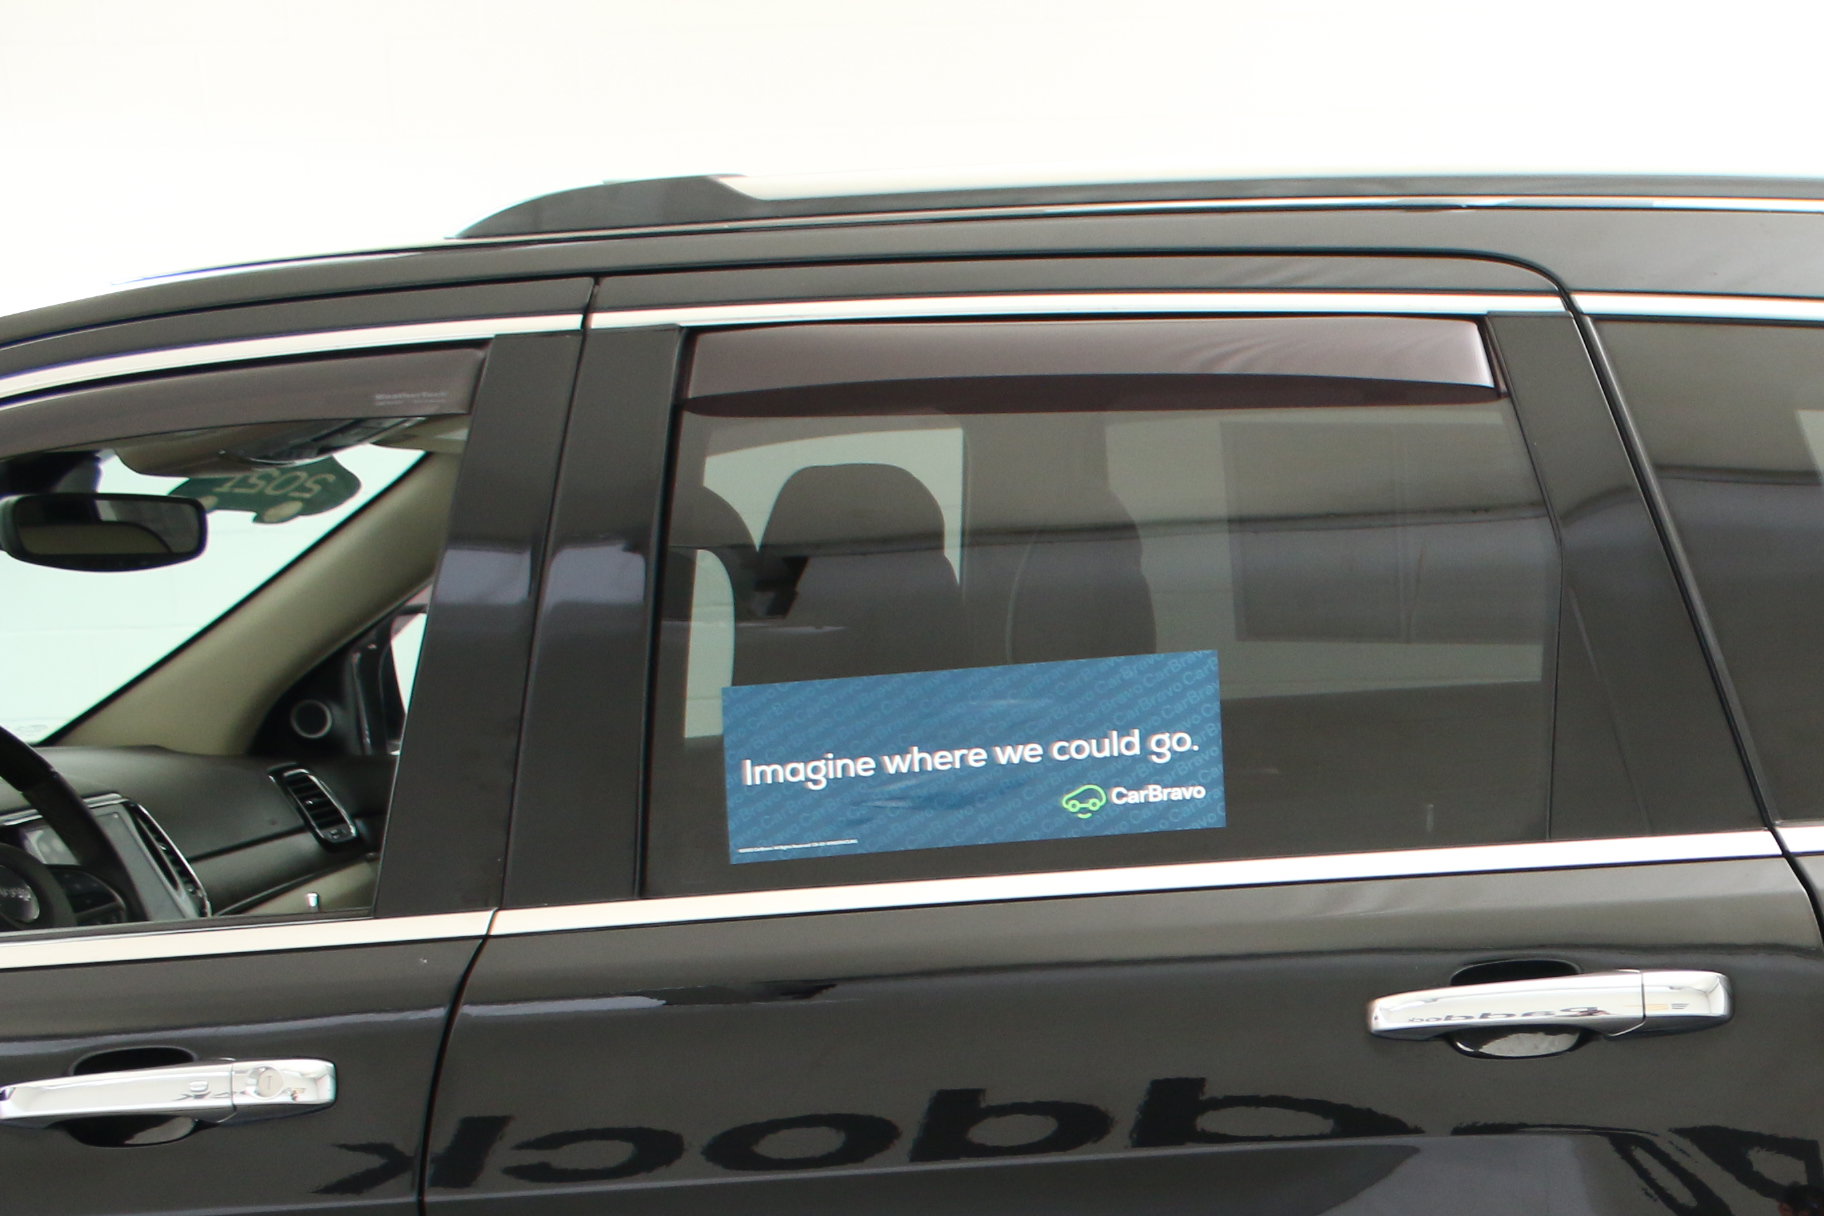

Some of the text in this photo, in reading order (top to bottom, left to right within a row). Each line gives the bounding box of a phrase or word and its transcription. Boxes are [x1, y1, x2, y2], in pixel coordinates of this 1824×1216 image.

[743, 728, 1200, 791] Imagine where we could go.
[1109, 783, 1206, 805] CarBravo
